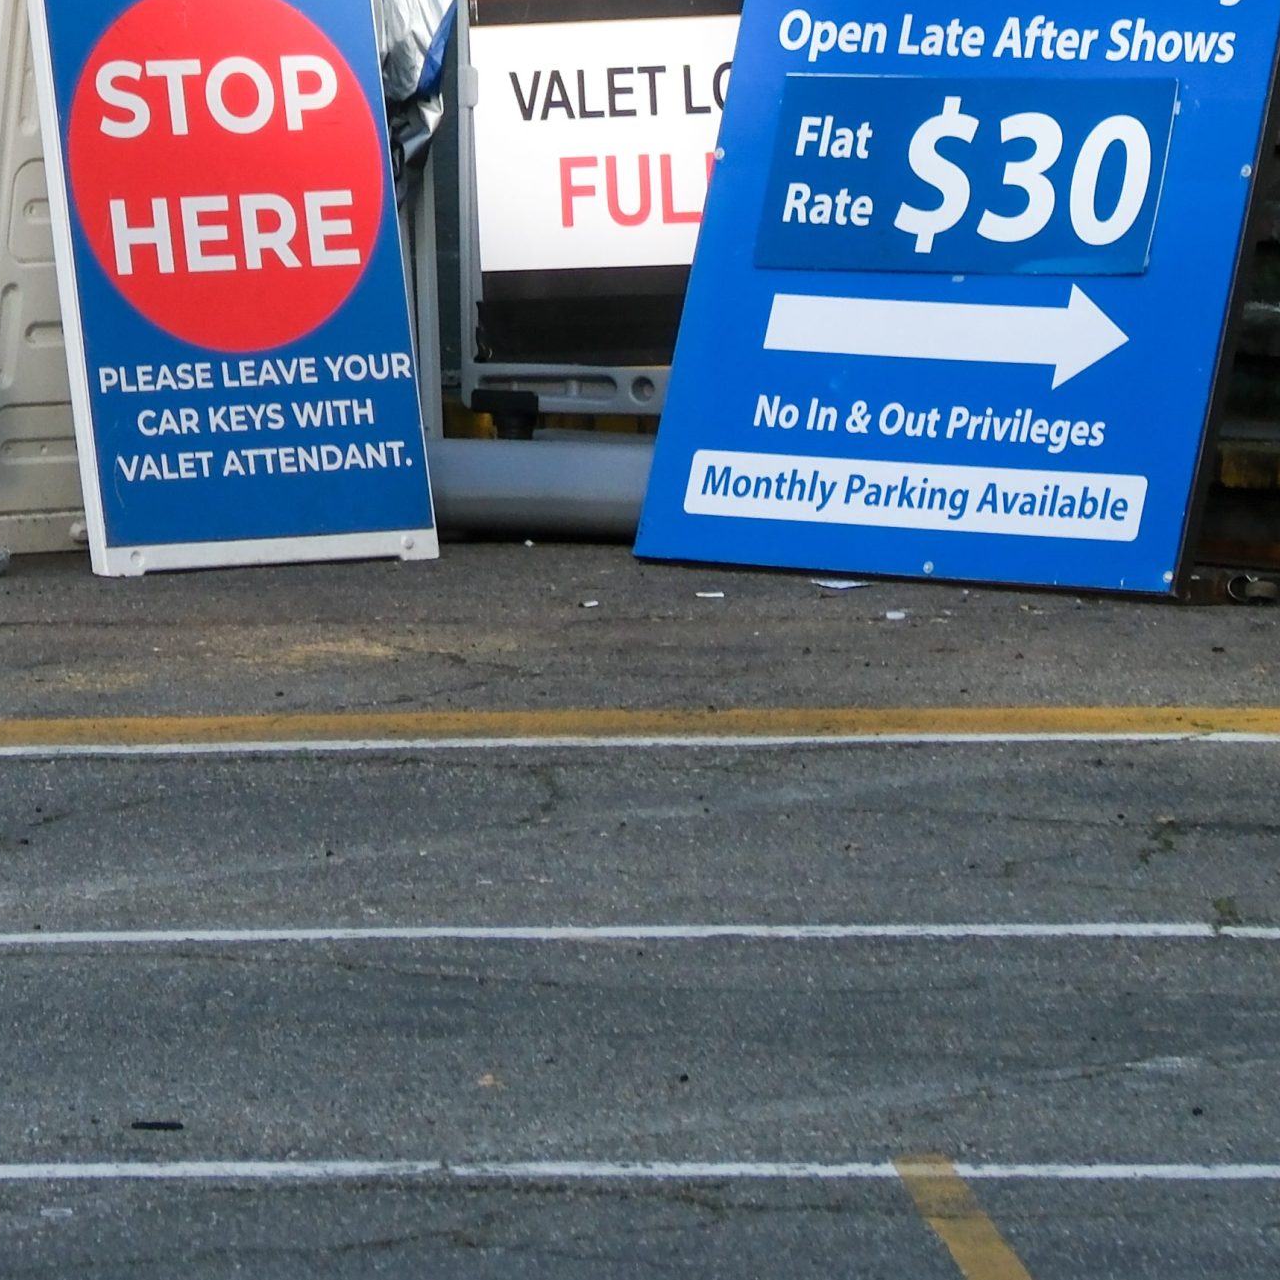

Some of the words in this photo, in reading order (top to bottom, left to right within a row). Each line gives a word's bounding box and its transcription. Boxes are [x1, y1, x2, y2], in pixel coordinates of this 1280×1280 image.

[779, 9, 887, 62] Open
[898, 14, 984, 57] Late
[993, 15, 1099, 59] After
[1106, 18, 1235, 63] Shows
[96, 55, 337, 138] STOP
[509, 66, 666, 121] VALET
[796, 116, 872, 158] Flat
[894, 96, 1151, 255] $30
[783, 183, 873, 226] Rate
[110, 190, 360, 275] HERE
[99, 363, 213, 393] PLEASE
[222, 358, 318, 387] LEAVE
[324, 353, 411, 381] YOUR
[138, 408, 200, 436] CAR
[208, 404, 284, 432] KEYS
[292, 398, 374, 427] WITH
[754, 395, 799, 428] No
[807, 398, 837, 431] In
[846, 401, 871, 433] &
[879, 403, 940, 437] Out
[946, 407, 1105, 453] Privileges
[117, 452, 213, 481] VALET
[223, 441, 412, 476] ATTENDANT.
[702, 466, 837, 511] Monthly
[844, 474, 969, 520] Parking
[976, 483, 1128, 521] Available
